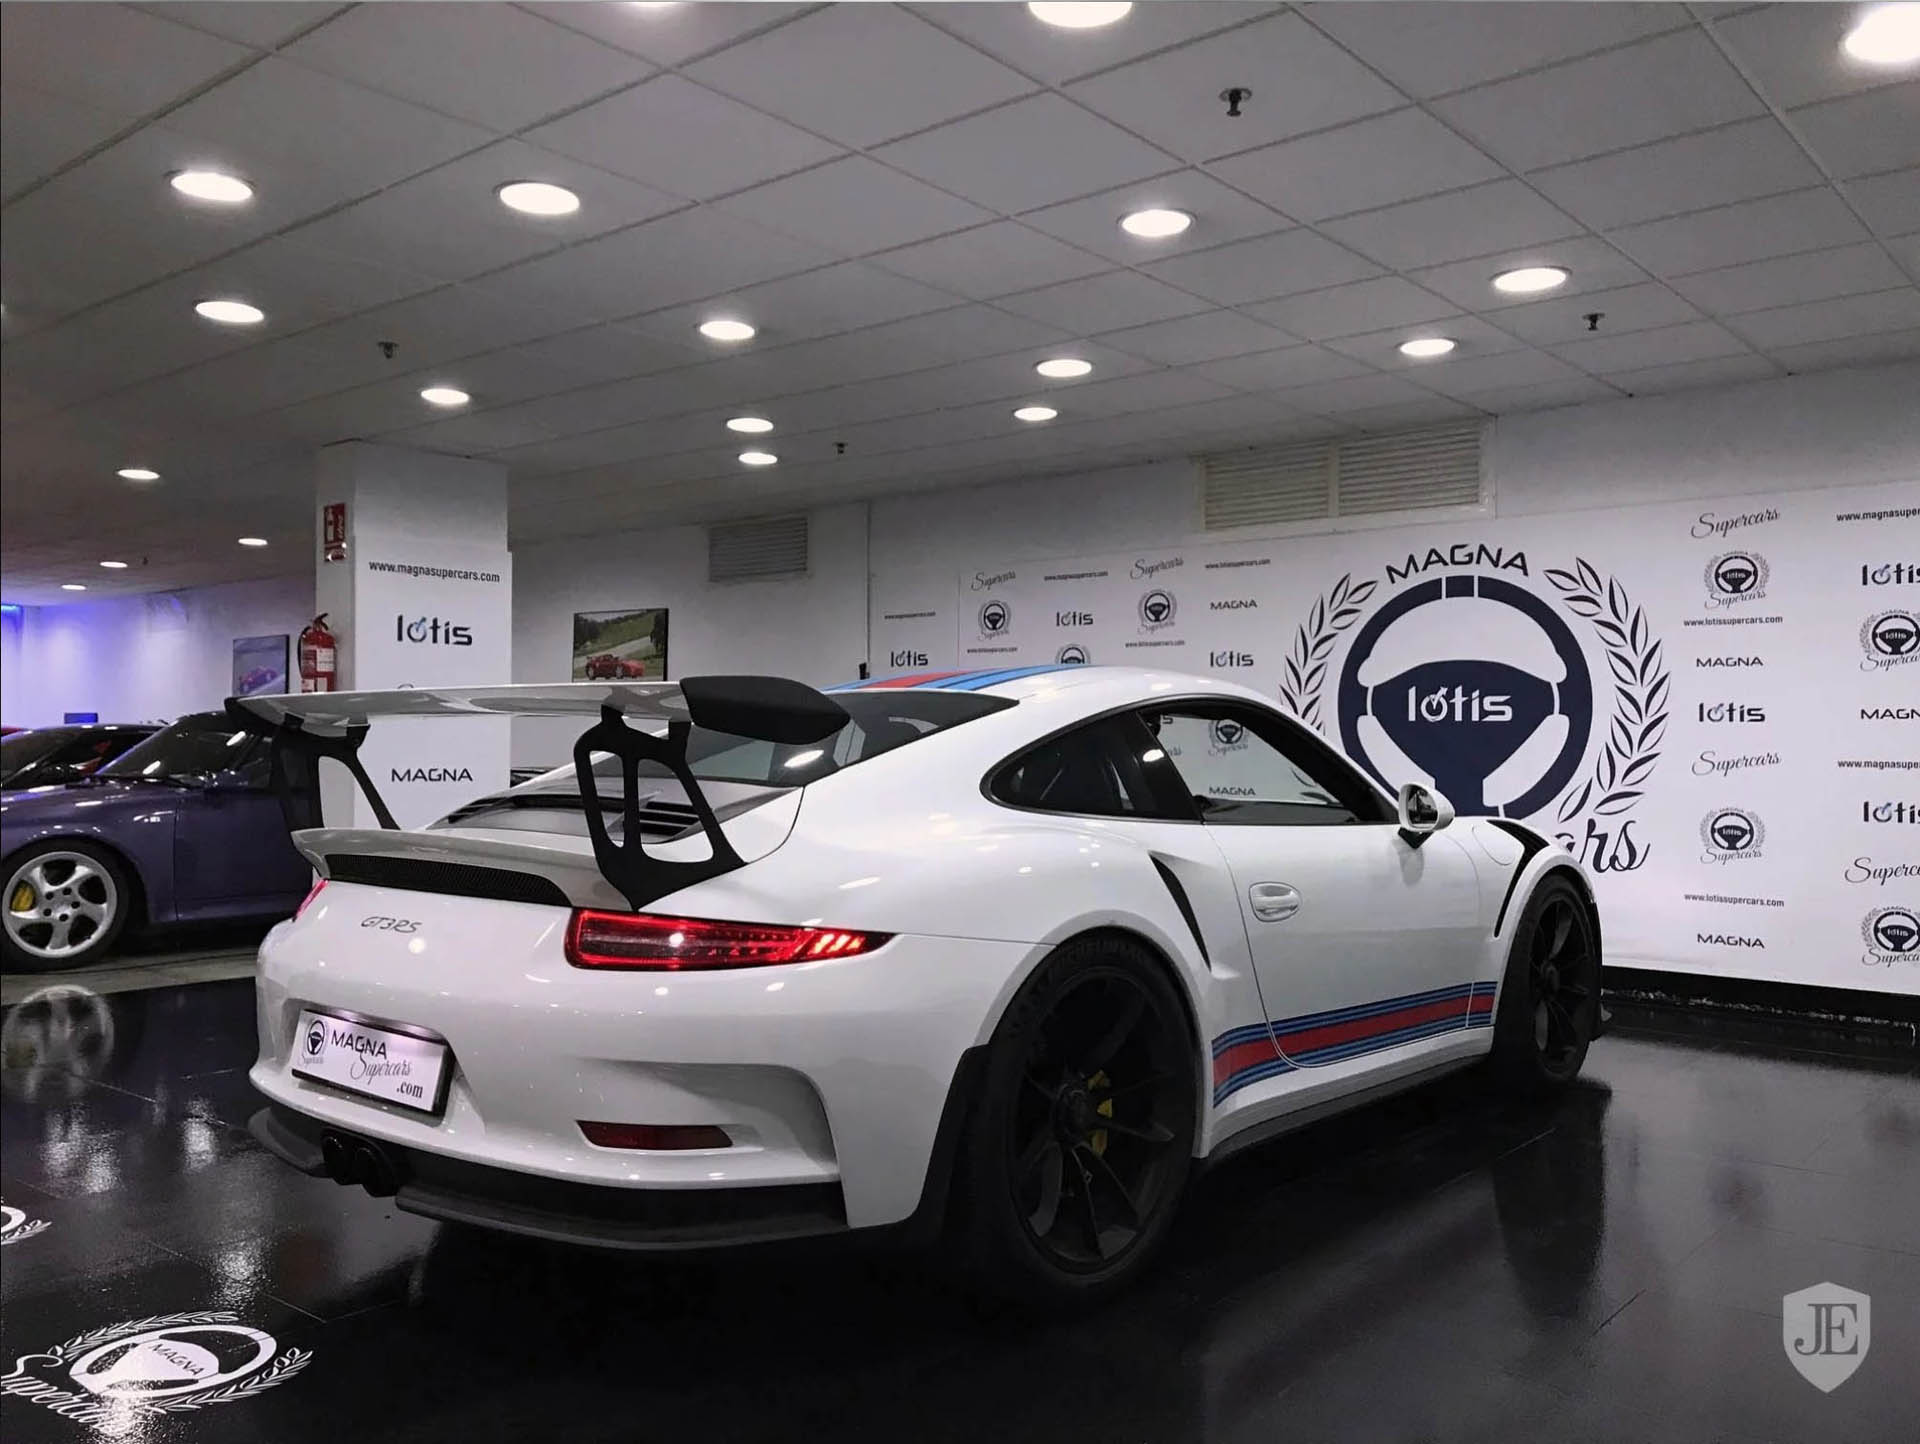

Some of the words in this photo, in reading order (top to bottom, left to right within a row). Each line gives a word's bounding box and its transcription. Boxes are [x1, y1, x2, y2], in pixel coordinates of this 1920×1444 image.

[1691, 508, 1781, 539] Supercars
[369, 561, 501, 583] www.magnasupercars.com
[1385, 543, 1529, 585] MAGNA
[1209, 599, 1258, 611] MAGNA
[1703, 590, 1767, 610] Supercars
[1055, 611, 1094, 627] lotis
[1683, 615, 1784, 627] www.lotissupercars.com
[396, 614, 473, 646] lotis
[890, 649, 929, 668] lotis
[1209, 650, 1255, 668] lotis
[1695, 656, 1764, 668] MAGNA
[1407, 685, 1514, 723] lotis
[1698, 701, 1766, 723] lotis
[1691, 750, 1780, 777] Supercars
[391, 767, 474, 782] MAGNA
[1208, 787, 1257, 796] MAGNA
[1863, 800, 1920, 824] loti
[1699, 847, 1763, 866] Supercars
[1683, 893, 1785, 908] www.lotissupercars.com
[1696, 933, 1766, 949] MAGNA
[330, 1029, 388, 1060] MAGNA
[350, 1052, 413, 1086] Supercars
[396, 1081, 424, 1099] .com
